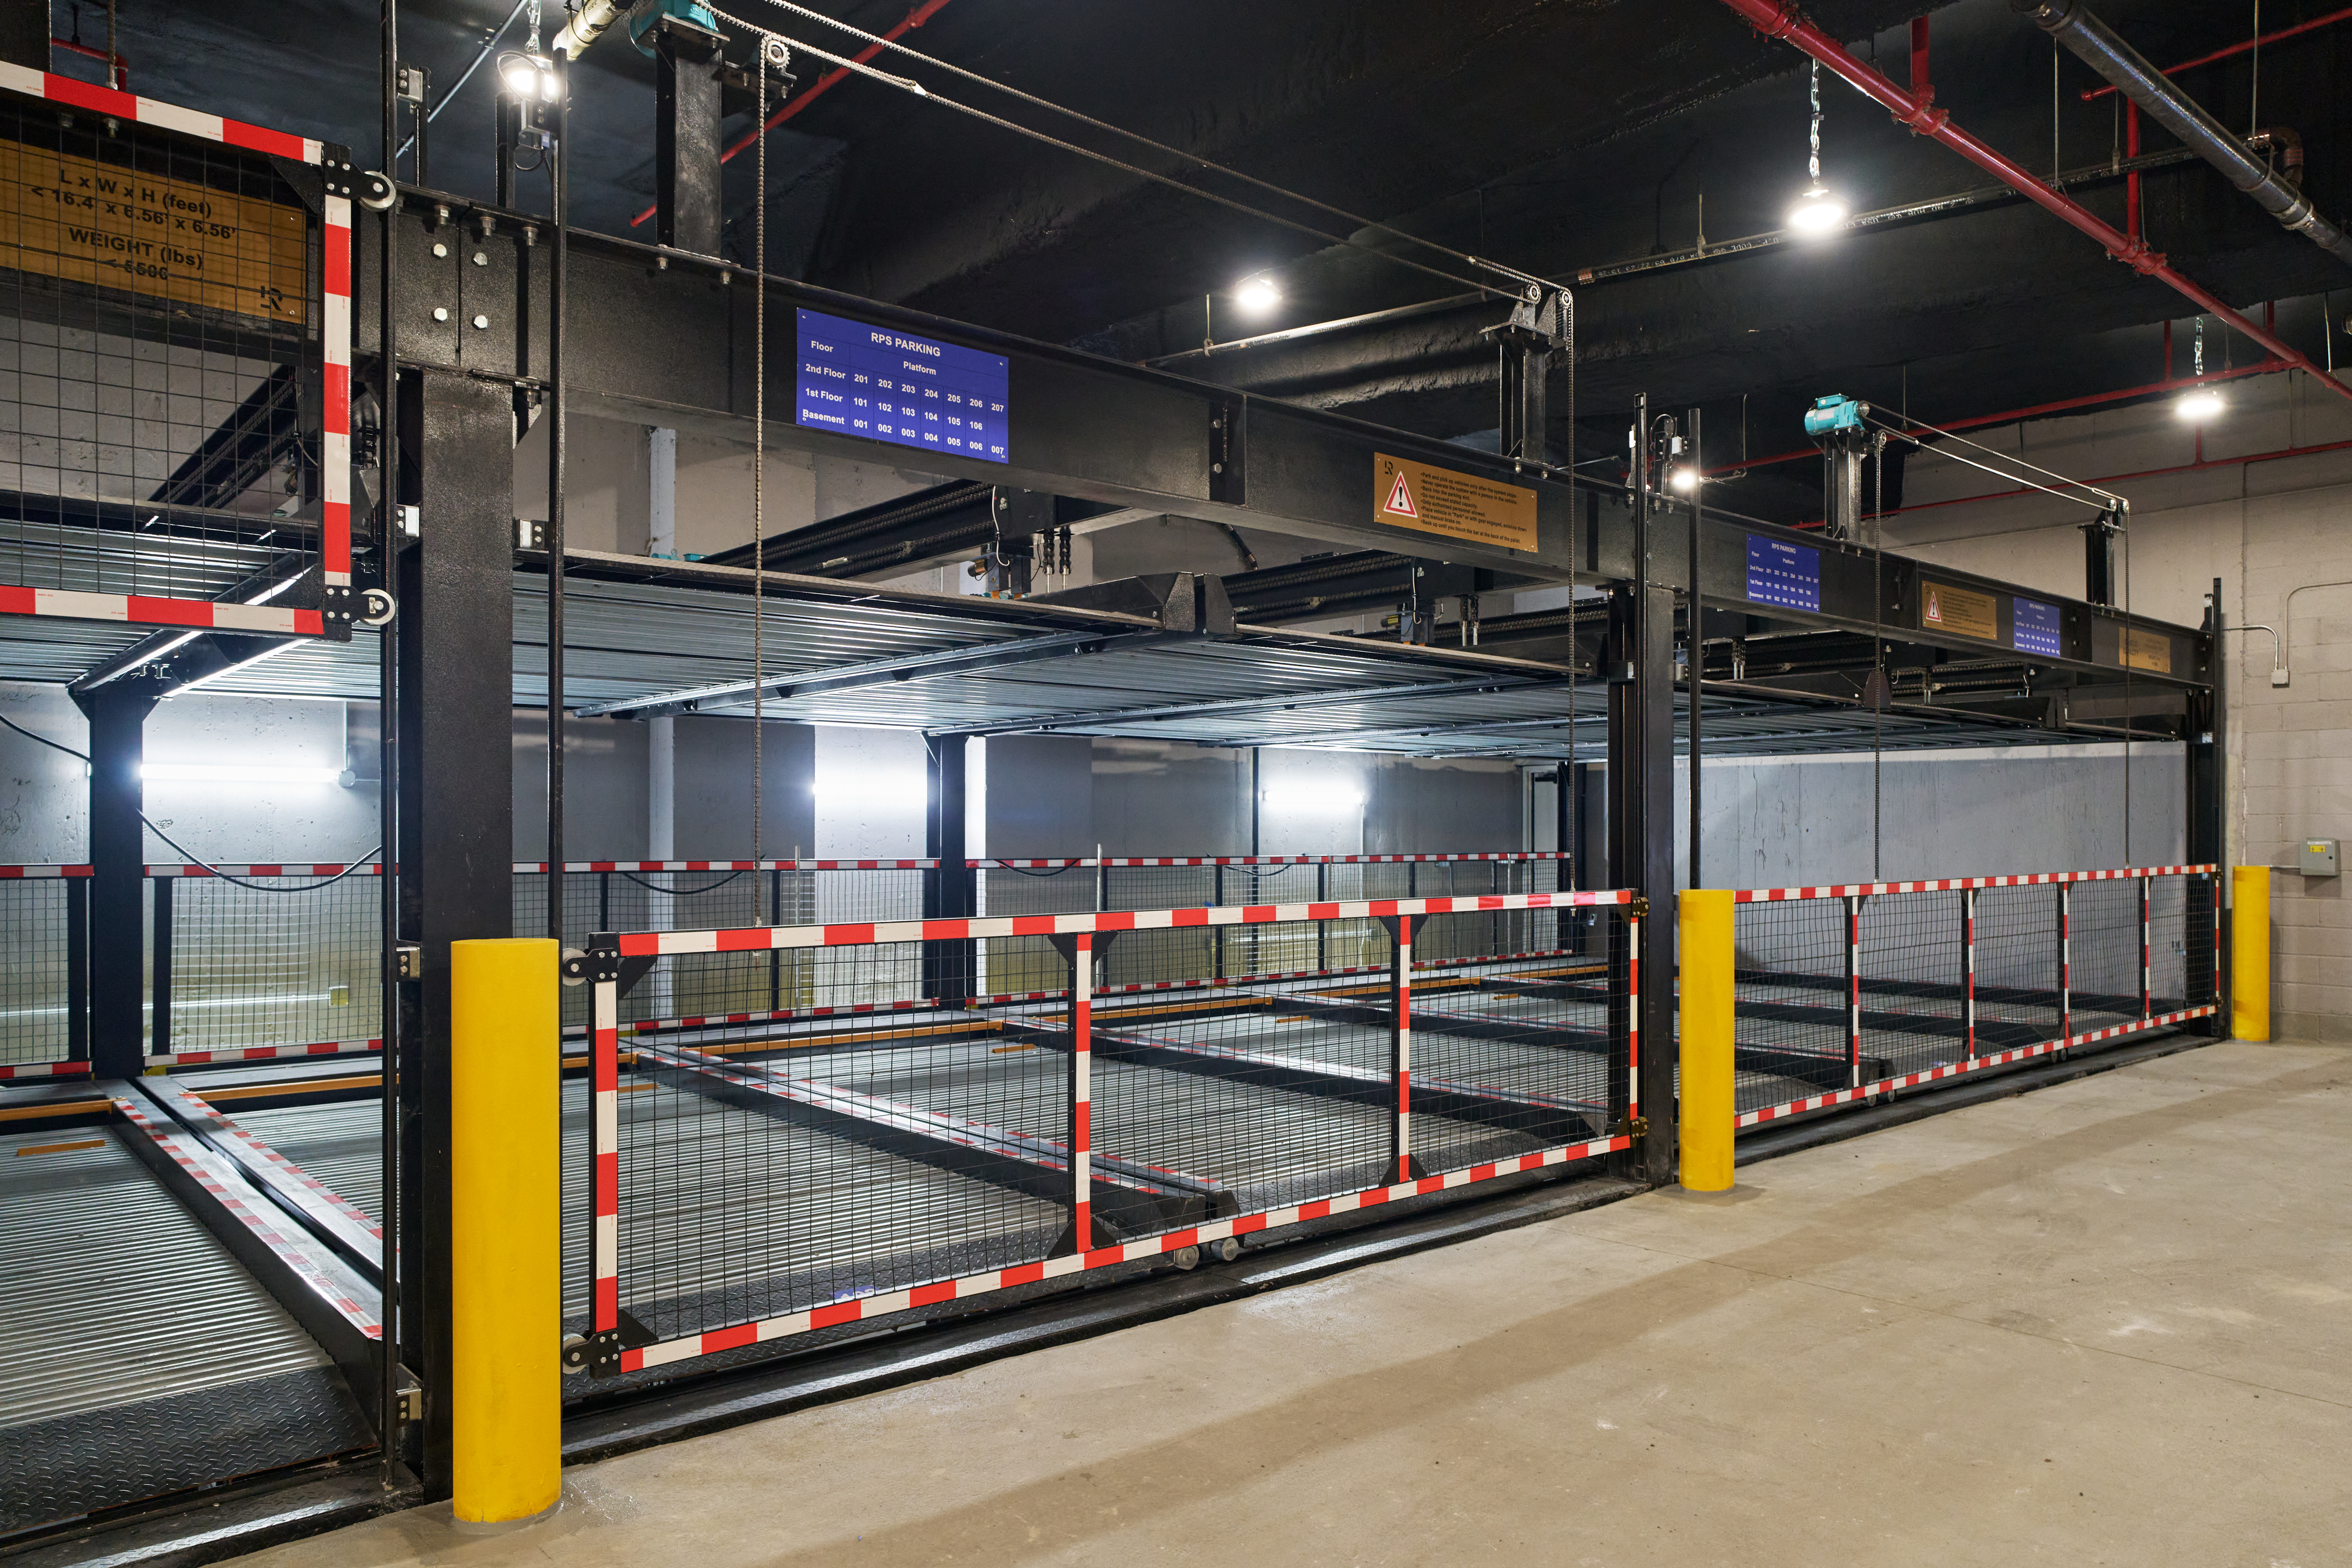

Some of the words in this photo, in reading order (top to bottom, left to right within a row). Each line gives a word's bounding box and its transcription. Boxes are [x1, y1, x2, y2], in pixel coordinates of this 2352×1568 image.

[30, 184, 44, 197] <
[51, 189, 100, 214] 16.4
[105, 200, 117, 215] x
[175, 215, 186, 230] x
[60, 168, 72, 185] L
[78, 177, 91, 189] x
[98, 177, 117, 194] W
[124, 187, 134, 199] x
[142, 188, 155, 203] H
[163, 195, 211, 218] (feet)
[69, 227, 154, 257] WEIGHT
[160, 244, 204, 271] (lbs)
[811, 340, 833, 353] Floor
[871, 332, 892, 346] RPS
[896, 338, 940, 357] PARKING
[904, 361, 936, 375] Platform
[805, 364, 821, 374] 2nd
[824, 367, 846, 379] Floor
[854, 374, 868, 384] 201
[878, 379, 892, 389] 202
[902, 384, 915, 394] 203
[925, 389, 938, 398] 204
[947, 394, 961, 403] 205
[970, 398, 983, 408] 206
[991, 403, 1004, 412] 207
[805, 388, 818, 398] 1st
[821, 390, 843, 402] Floor
[854, 397, 867, 407] 101
[878, 402, 891, 412] 102
[902, 407, 915, 416] 103
[925, 412, 938, 421] 104
[948, 416, 961, 426] 105
[970, 421, 983, 430] 106
[803, 409, 844, 425] Basement
[854, 419, 868, 429] 001
[878, 423, 892, 433] 002
[901, 428, 915, 438] 003
[925, 433, 938, 442] 004
[947, 437, 961, 446] 005
[970, 441, 983, 451] 006
[991, 445, 1004, 454] 007
[1432, 502, 1452, 510] authorized
[1448, 492, 1462, 500] parking
[1780, 545, 1796, 553] PARKING
